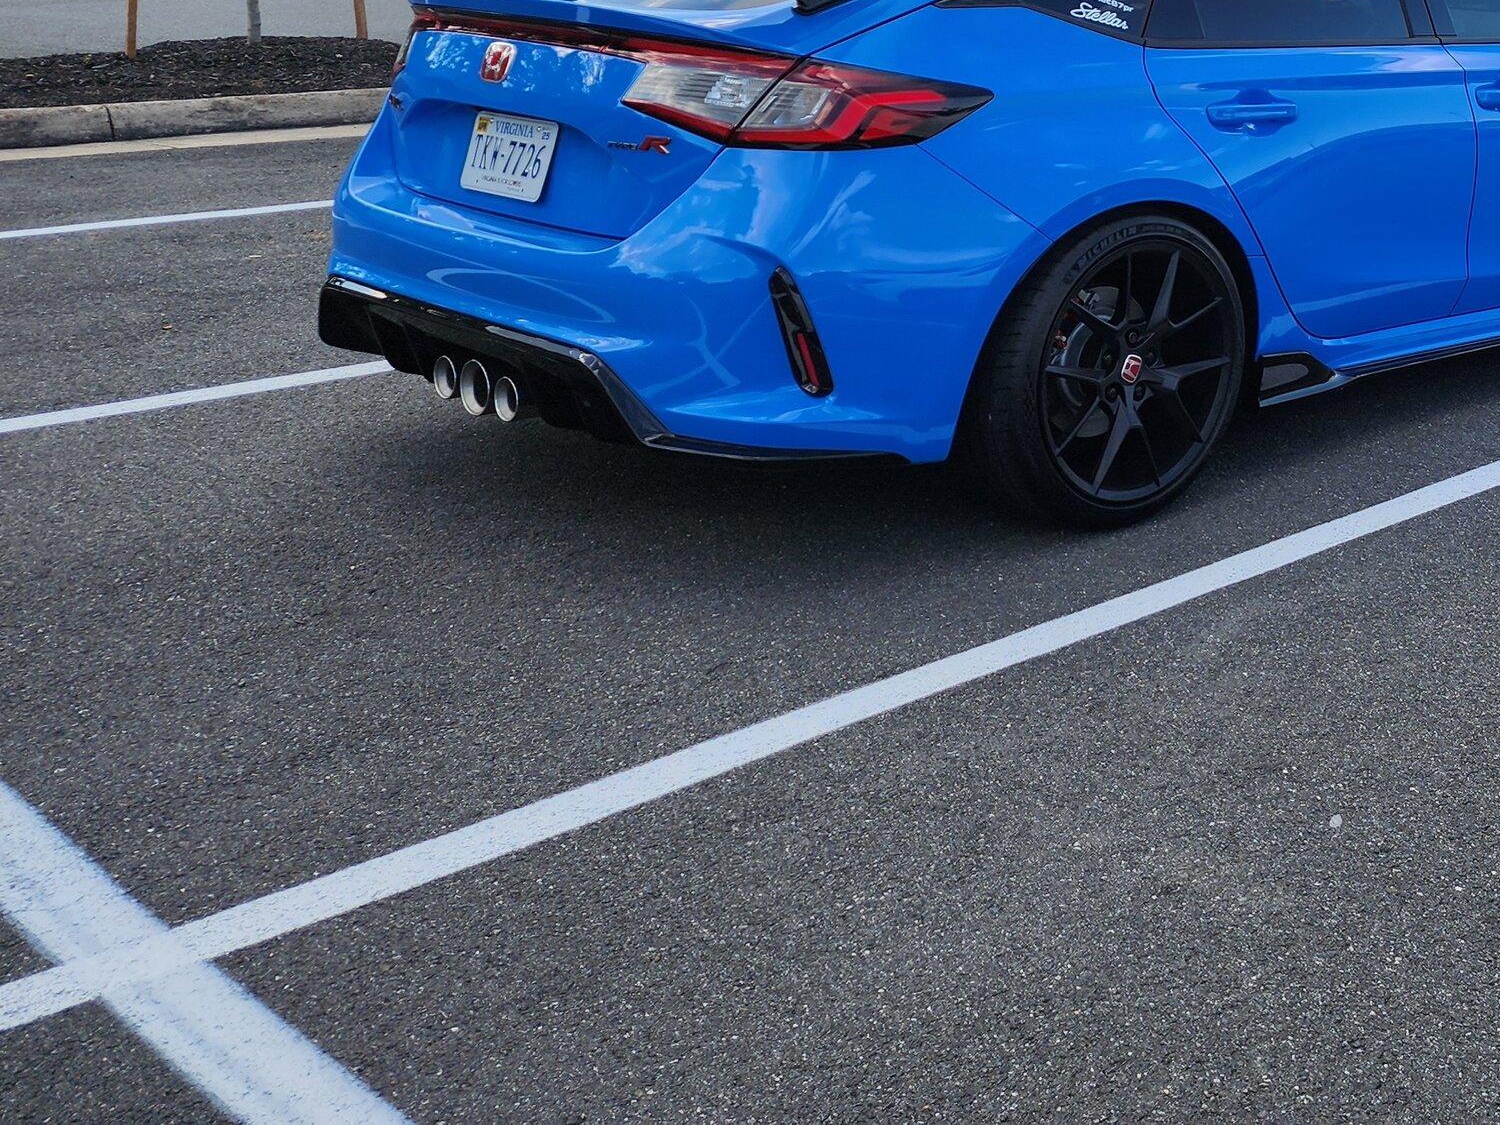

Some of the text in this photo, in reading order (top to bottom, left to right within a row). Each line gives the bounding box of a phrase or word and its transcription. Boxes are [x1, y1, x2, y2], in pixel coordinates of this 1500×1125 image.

[1070, 2, 1129, 30] Stellar
[495, 120, 534, 139] VIRGINIA
[541, 132, 551, 141] 25
[640, 135, 672, 155] R
[471, 133, 547, 179] TKW-7726
